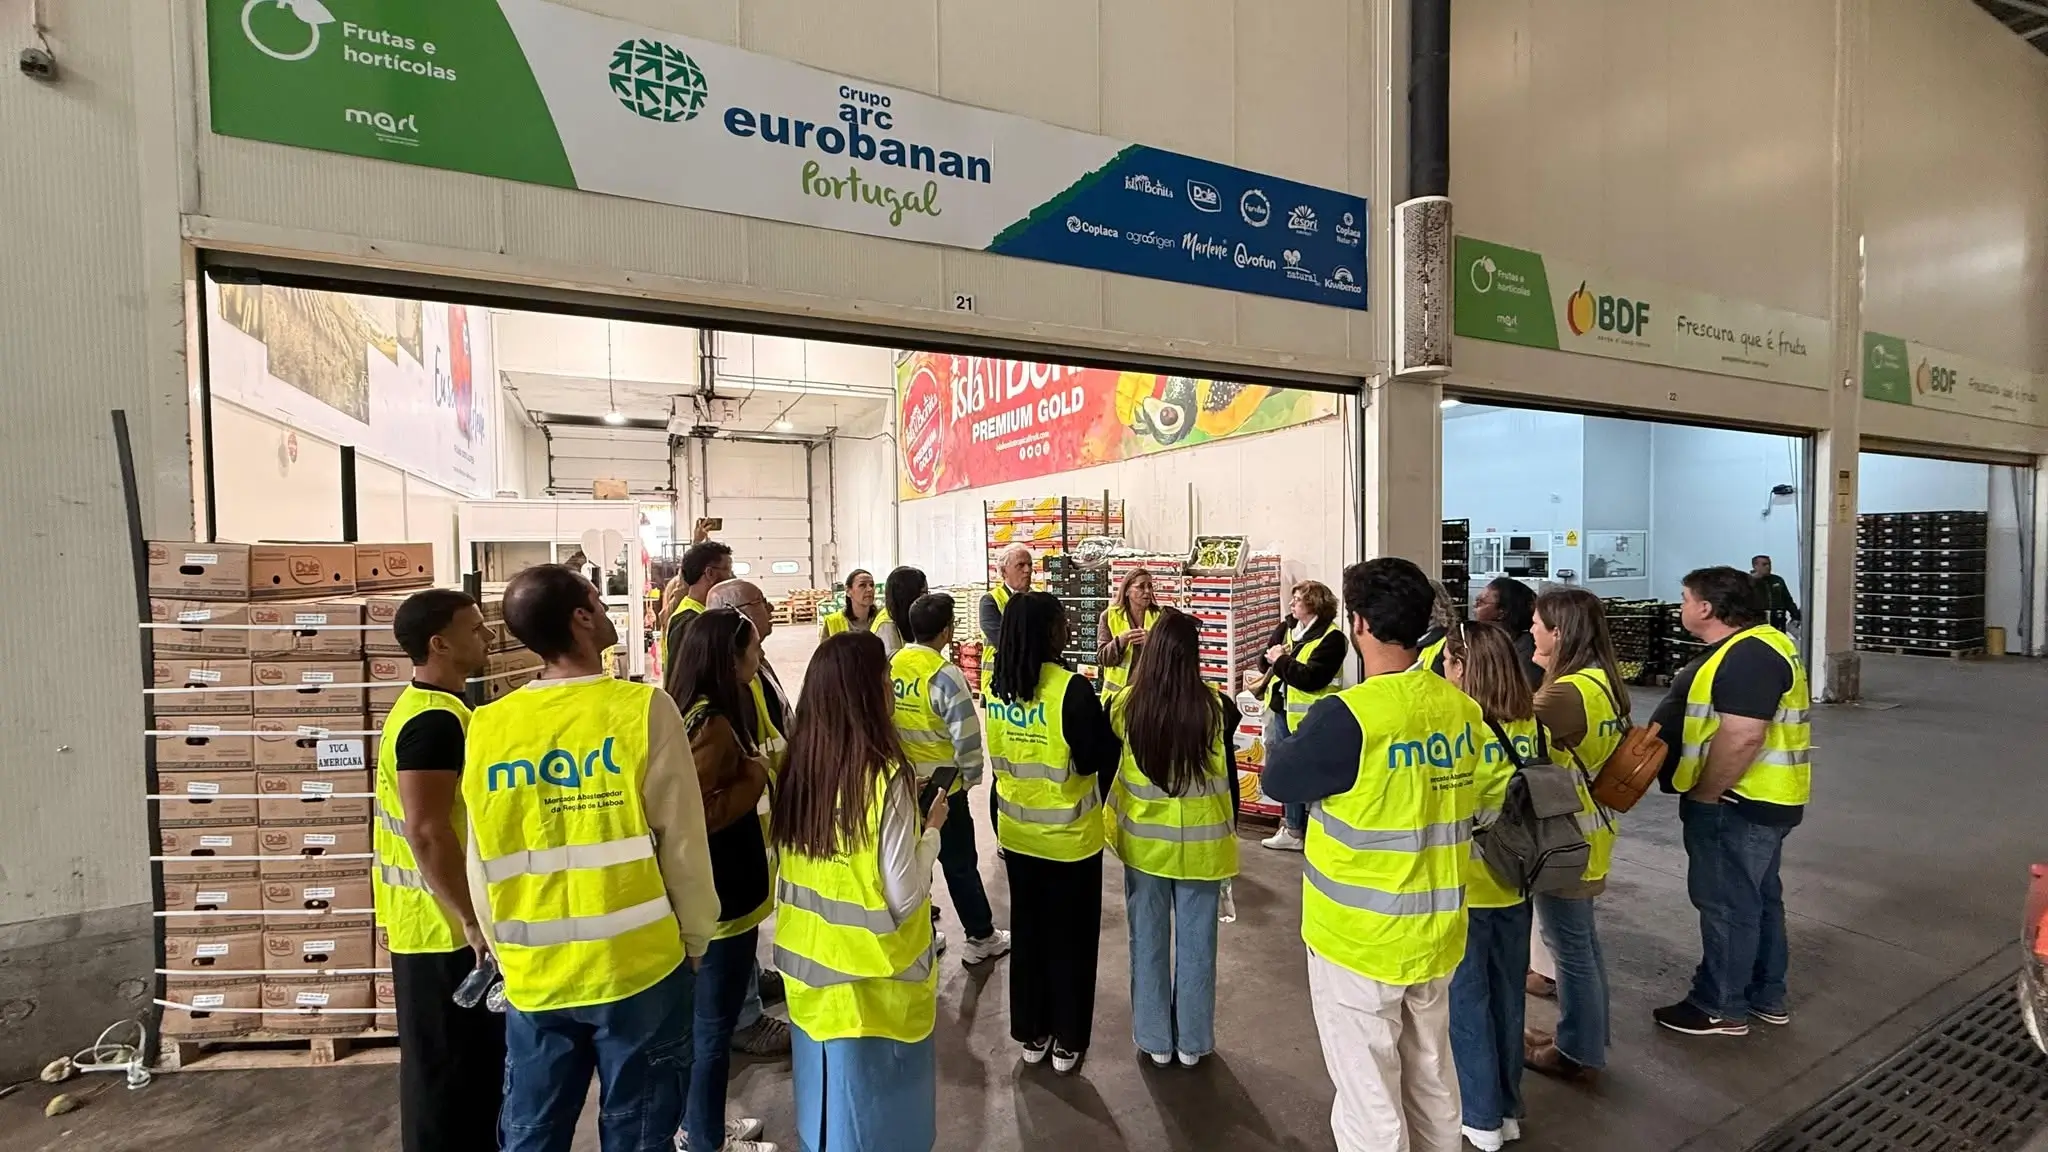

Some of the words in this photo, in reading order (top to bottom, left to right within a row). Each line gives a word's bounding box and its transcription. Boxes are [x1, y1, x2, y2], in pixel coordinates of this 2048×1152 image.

[343, 22, 416, 51] Frutas
[423, 41, 436, 55] e
[343, 45, 457, 82] hortícolas
[839, 84, 892, 108] Grupo
[345, 107, 419, 134] marl
[839, 102, 894, 131] arc
[723, 106, 992, 185] eurobanan
[801, 160, 943, 227] Portugal
[1193, 186, 1217, 202] Dole
[1082, 221, 1119, 239] Coplaca
[1287, 211, 1319, 232] Zespri
[955, 295, 973, 311] 21
[1598, 295, 1651, 338] BDF
[1677, 314, 1735, 345] Frescura
[1741, 332, 1762, 356] que
[1767, 328, 1775, 350] é
[1778, 330, 1807, 357] fruta
[1931, 366, 1957, 394] BDF
[972, 402, 1033, 445] PREMIUM
[1037, 385, 1085, 424] GOLD
[295, 560, 320, 575] Dole
[388, 556, 408, 569] Dole
[255, 611, 279, 622] Dole
[260, 668, 283, 679] Dole
[373, 663, 397, 674] Dole
[893, 677, 921, 699] arl
[987, 702, 1047, 728] marl
[328, 744, 349, 753] YUCA
[1388, 721, 1476, 769] marl
[318, 756, 363, 768] AMERICANA
[488, 736, 621, 792] marl
[544, 795, 576, 805] Mercado
[550, 806, 561, 814] da
[597, 799, 625, 808] Lisboa
[265, 833, 288, 845] Dole
